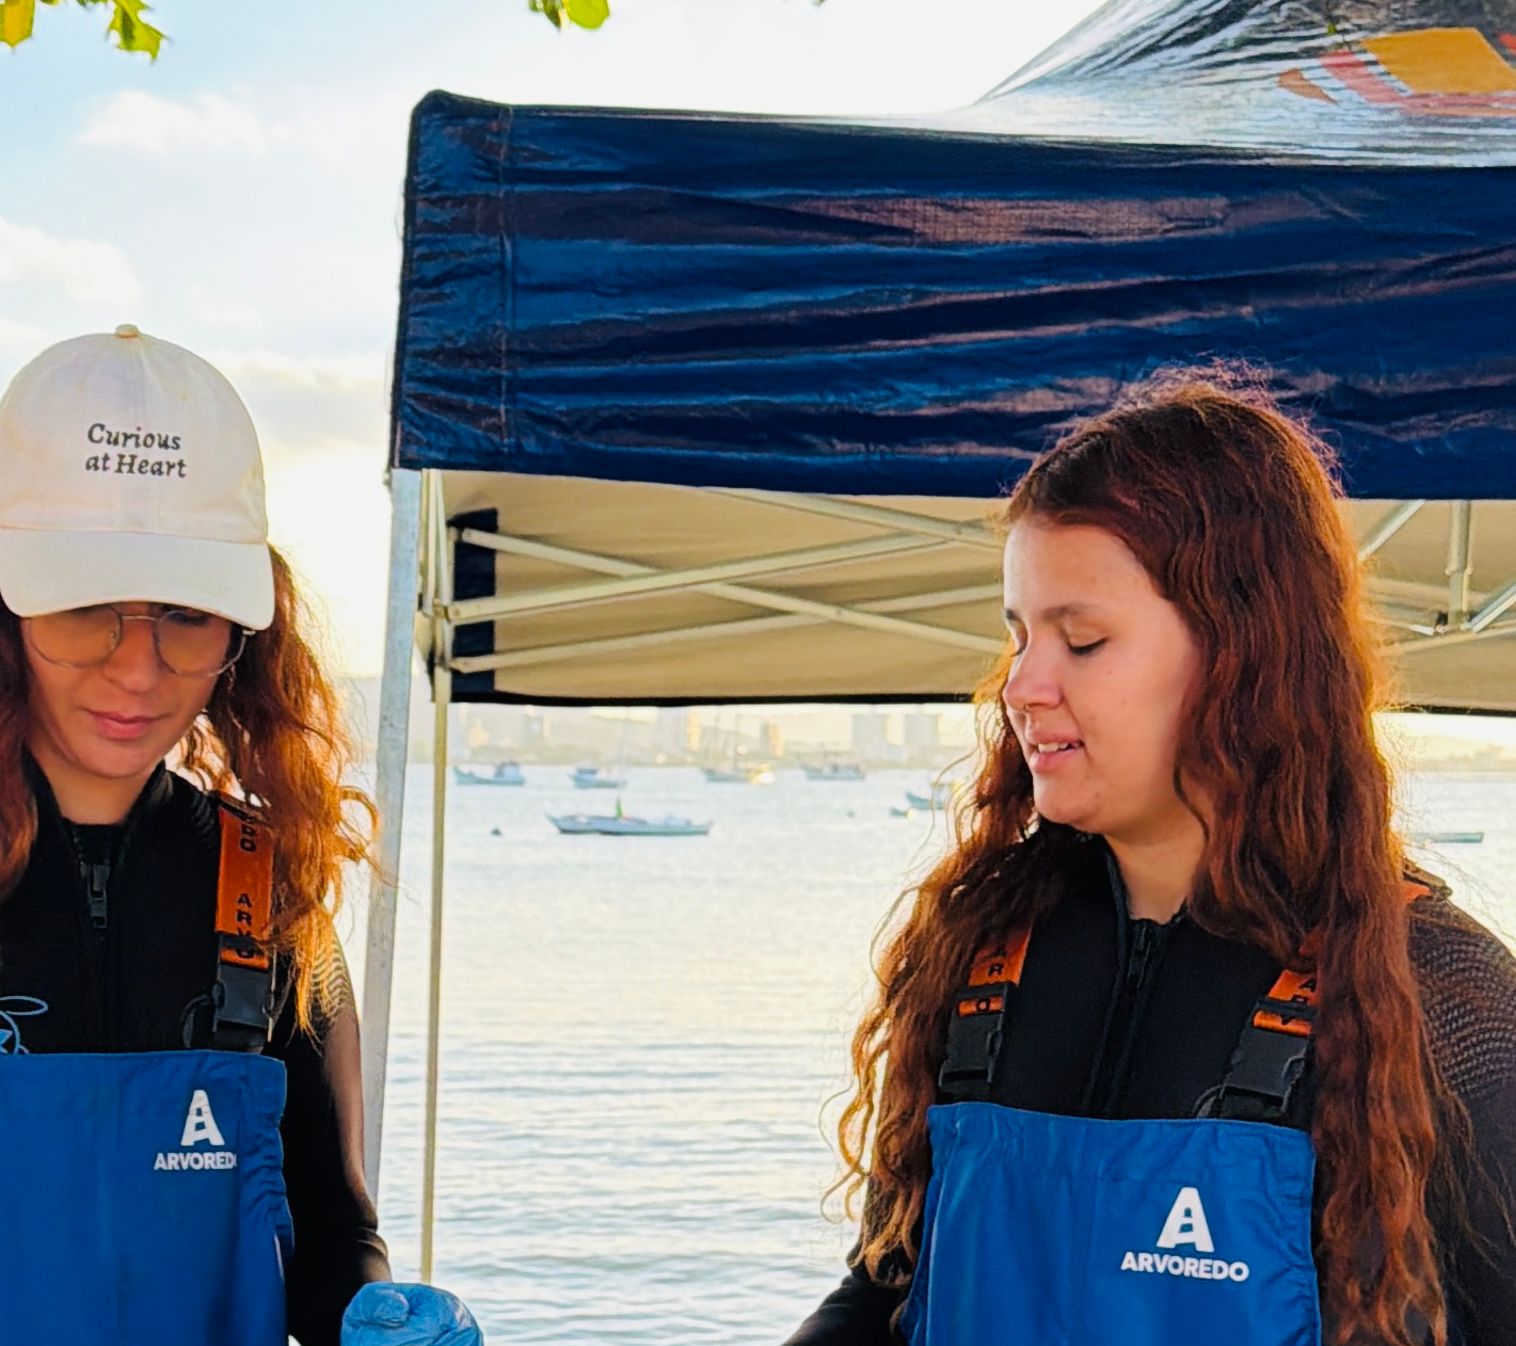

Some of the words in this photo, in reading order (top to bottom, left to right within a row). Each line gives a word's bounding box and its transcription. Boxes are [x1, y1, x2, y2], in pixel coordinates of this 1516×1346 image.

[87, 422, 182, 451] Curious
[84, 452, 111, 472] at
[113, 453, 187, 478] Heart
[1120, 1250, 1251, 1283] ARVOREDO
